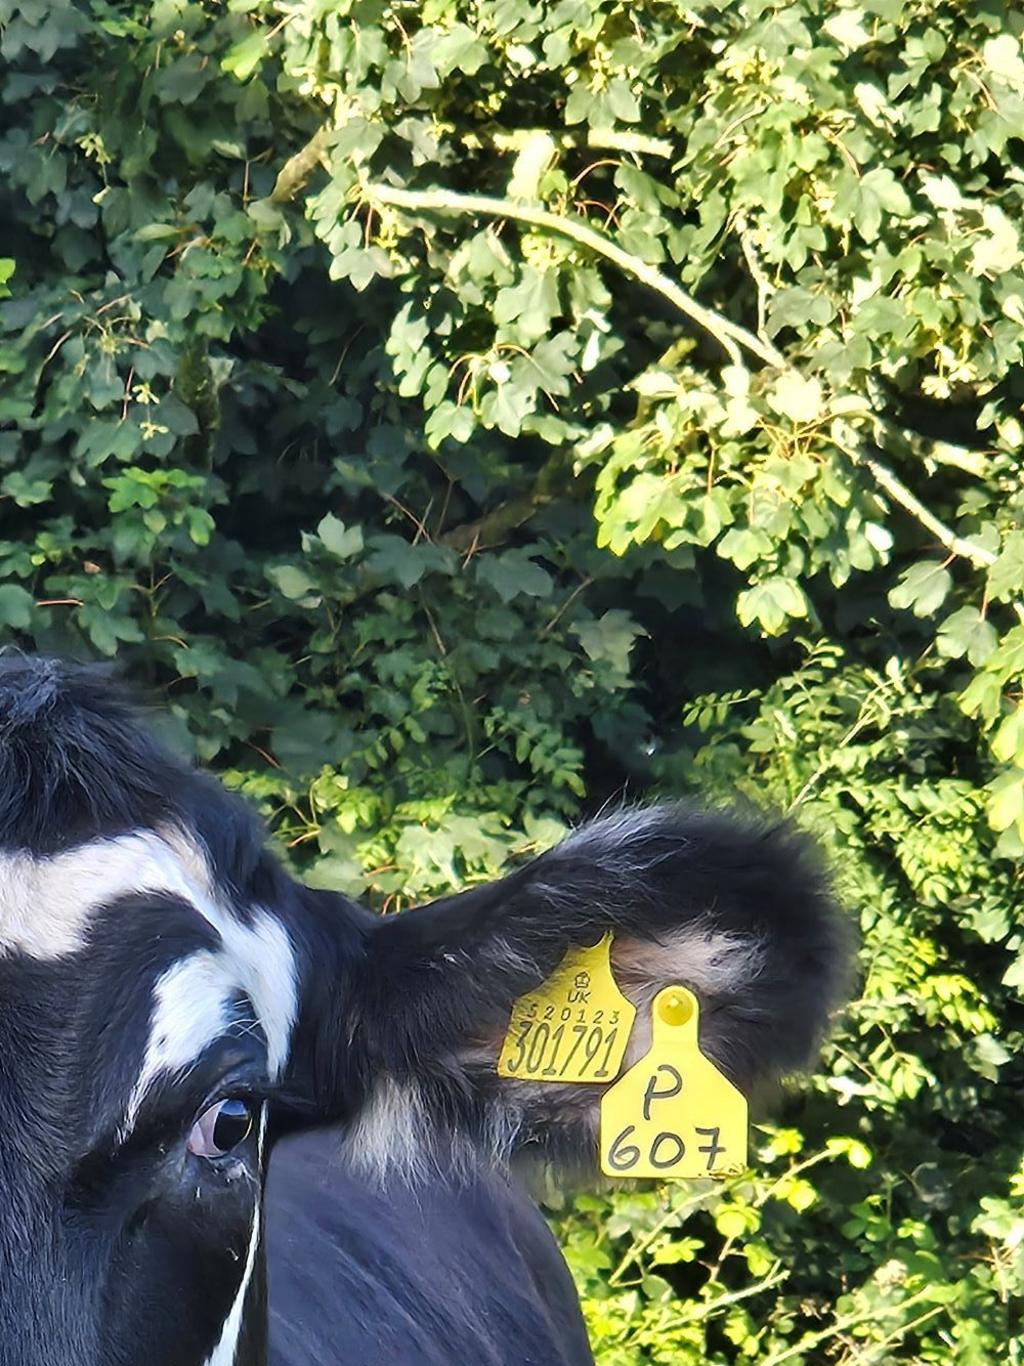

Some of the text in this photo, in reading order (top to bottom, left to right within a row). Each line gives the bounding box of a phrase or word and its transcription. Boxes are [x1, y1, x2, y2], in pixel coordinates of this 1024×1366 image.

[567, 991, 591, 1004] UK
[508, 1020, 618, 1078] 301791
[643, 1064, 683, 1121] P
[608, 1125, 726, 1171] 607
